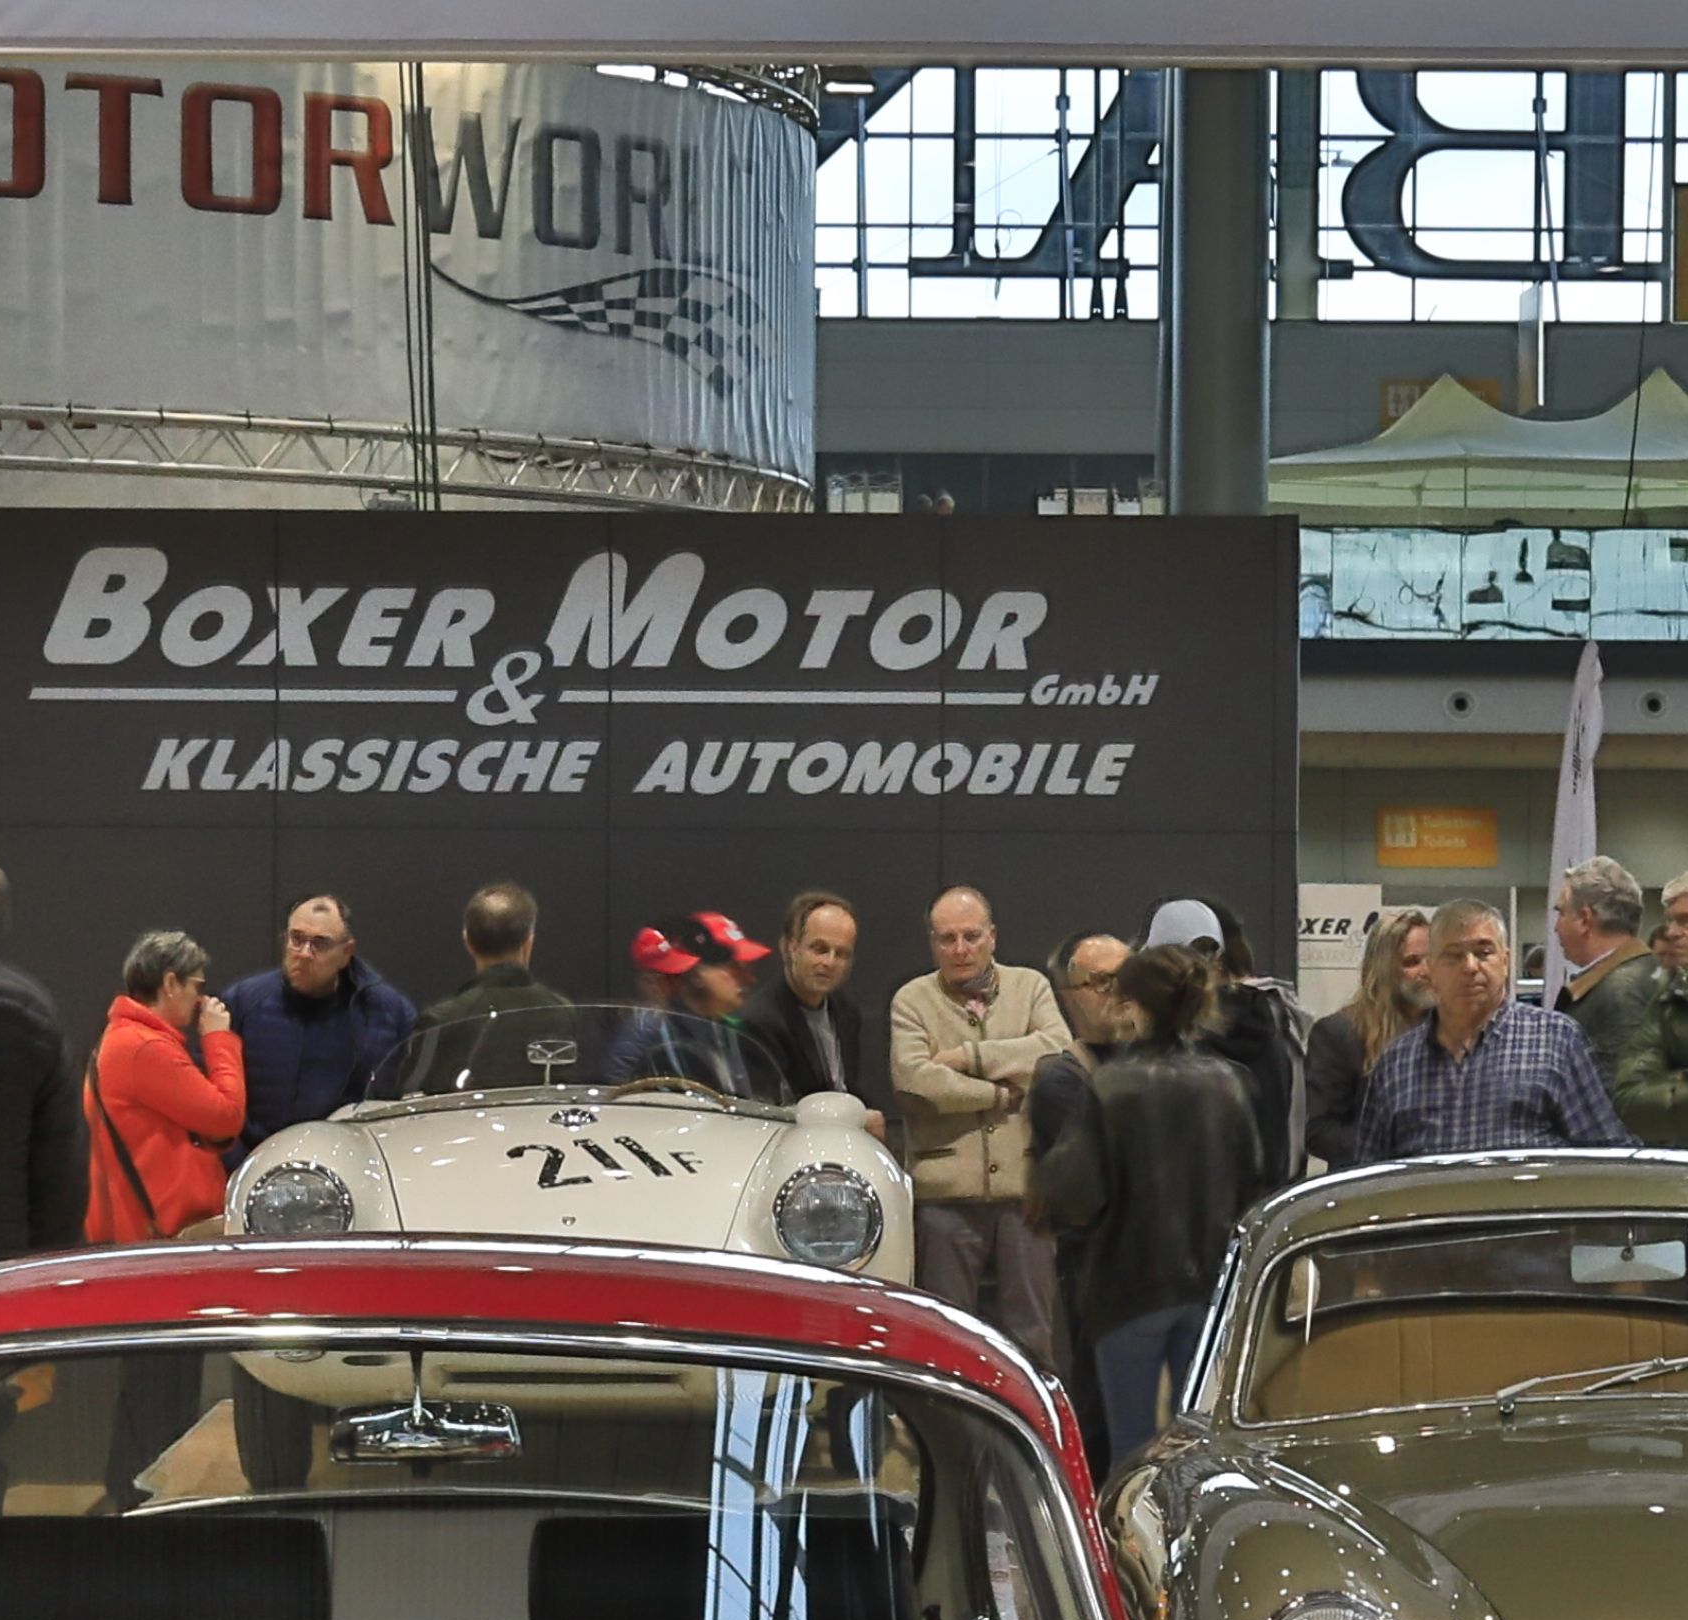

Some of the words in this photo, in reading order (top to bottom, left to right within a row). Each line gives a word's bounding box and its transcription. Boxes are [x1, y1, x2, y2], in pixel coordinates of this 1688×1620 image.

[41, 546, 494, 667] BOXER
[542, 550, 1048, 672] MOTOR
[1030, 674, 1159, 706] GmbH
[465, 651, 545, 726] &
[141, 737, 600, 793] KLASSISCHE
[631, 737, 1136, 796] AUTOMOBILE
[1298, 918, 1352, 935] XER
